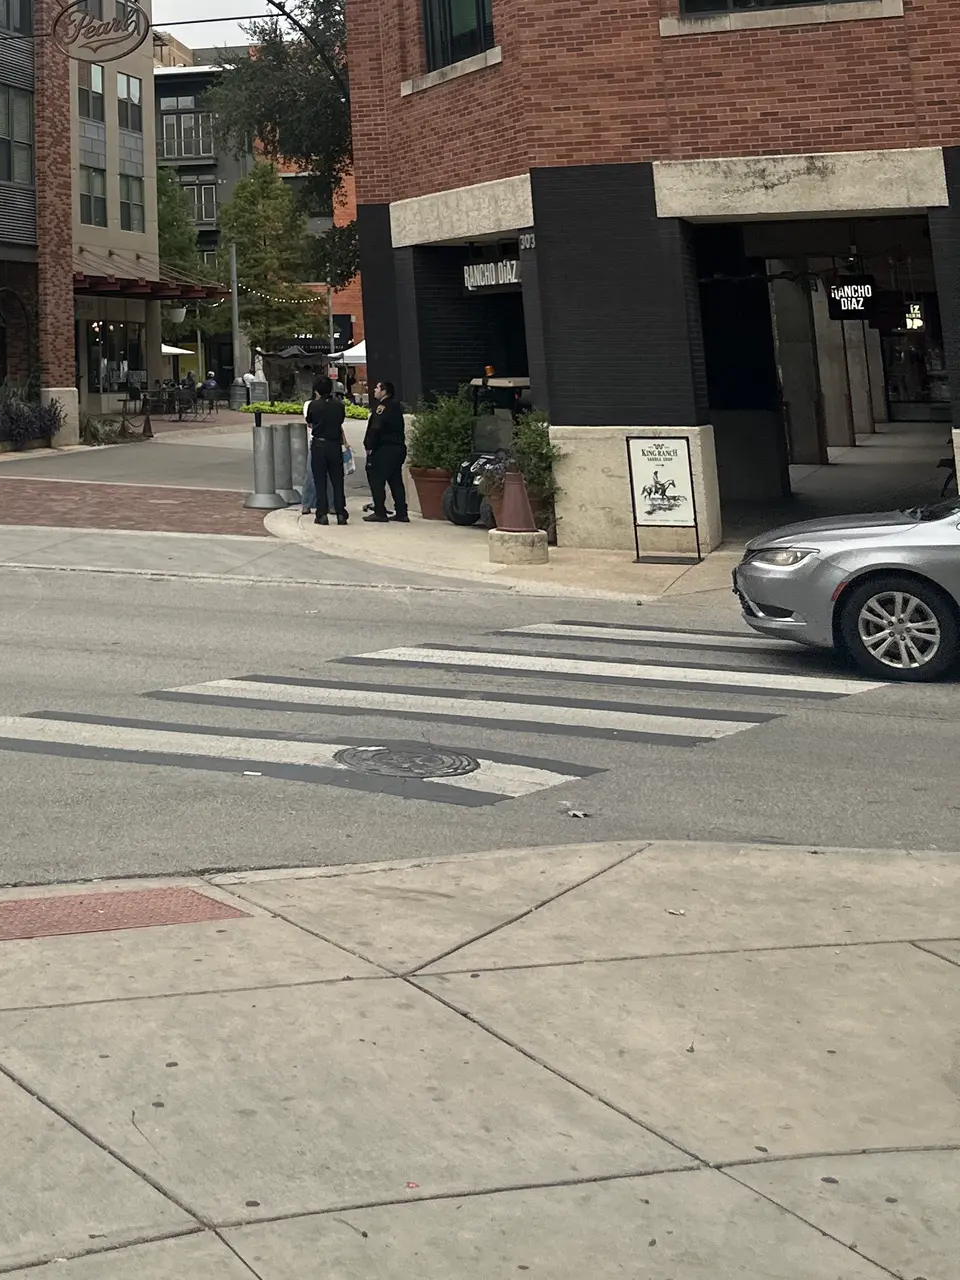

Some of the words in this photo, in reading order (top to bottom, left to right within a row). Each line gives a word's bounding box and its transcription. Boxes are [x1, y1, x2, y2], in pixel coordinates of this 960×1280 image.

[62, 8, 138, 52] Pearl
[520, 234, 535, 249] 303
[463, 262, 496, 291] RANCHO
[831, 285, 872, 299] RANCHO
[641, 448, 657, 457] KING
[658, 448, 678, 457] RANCH
